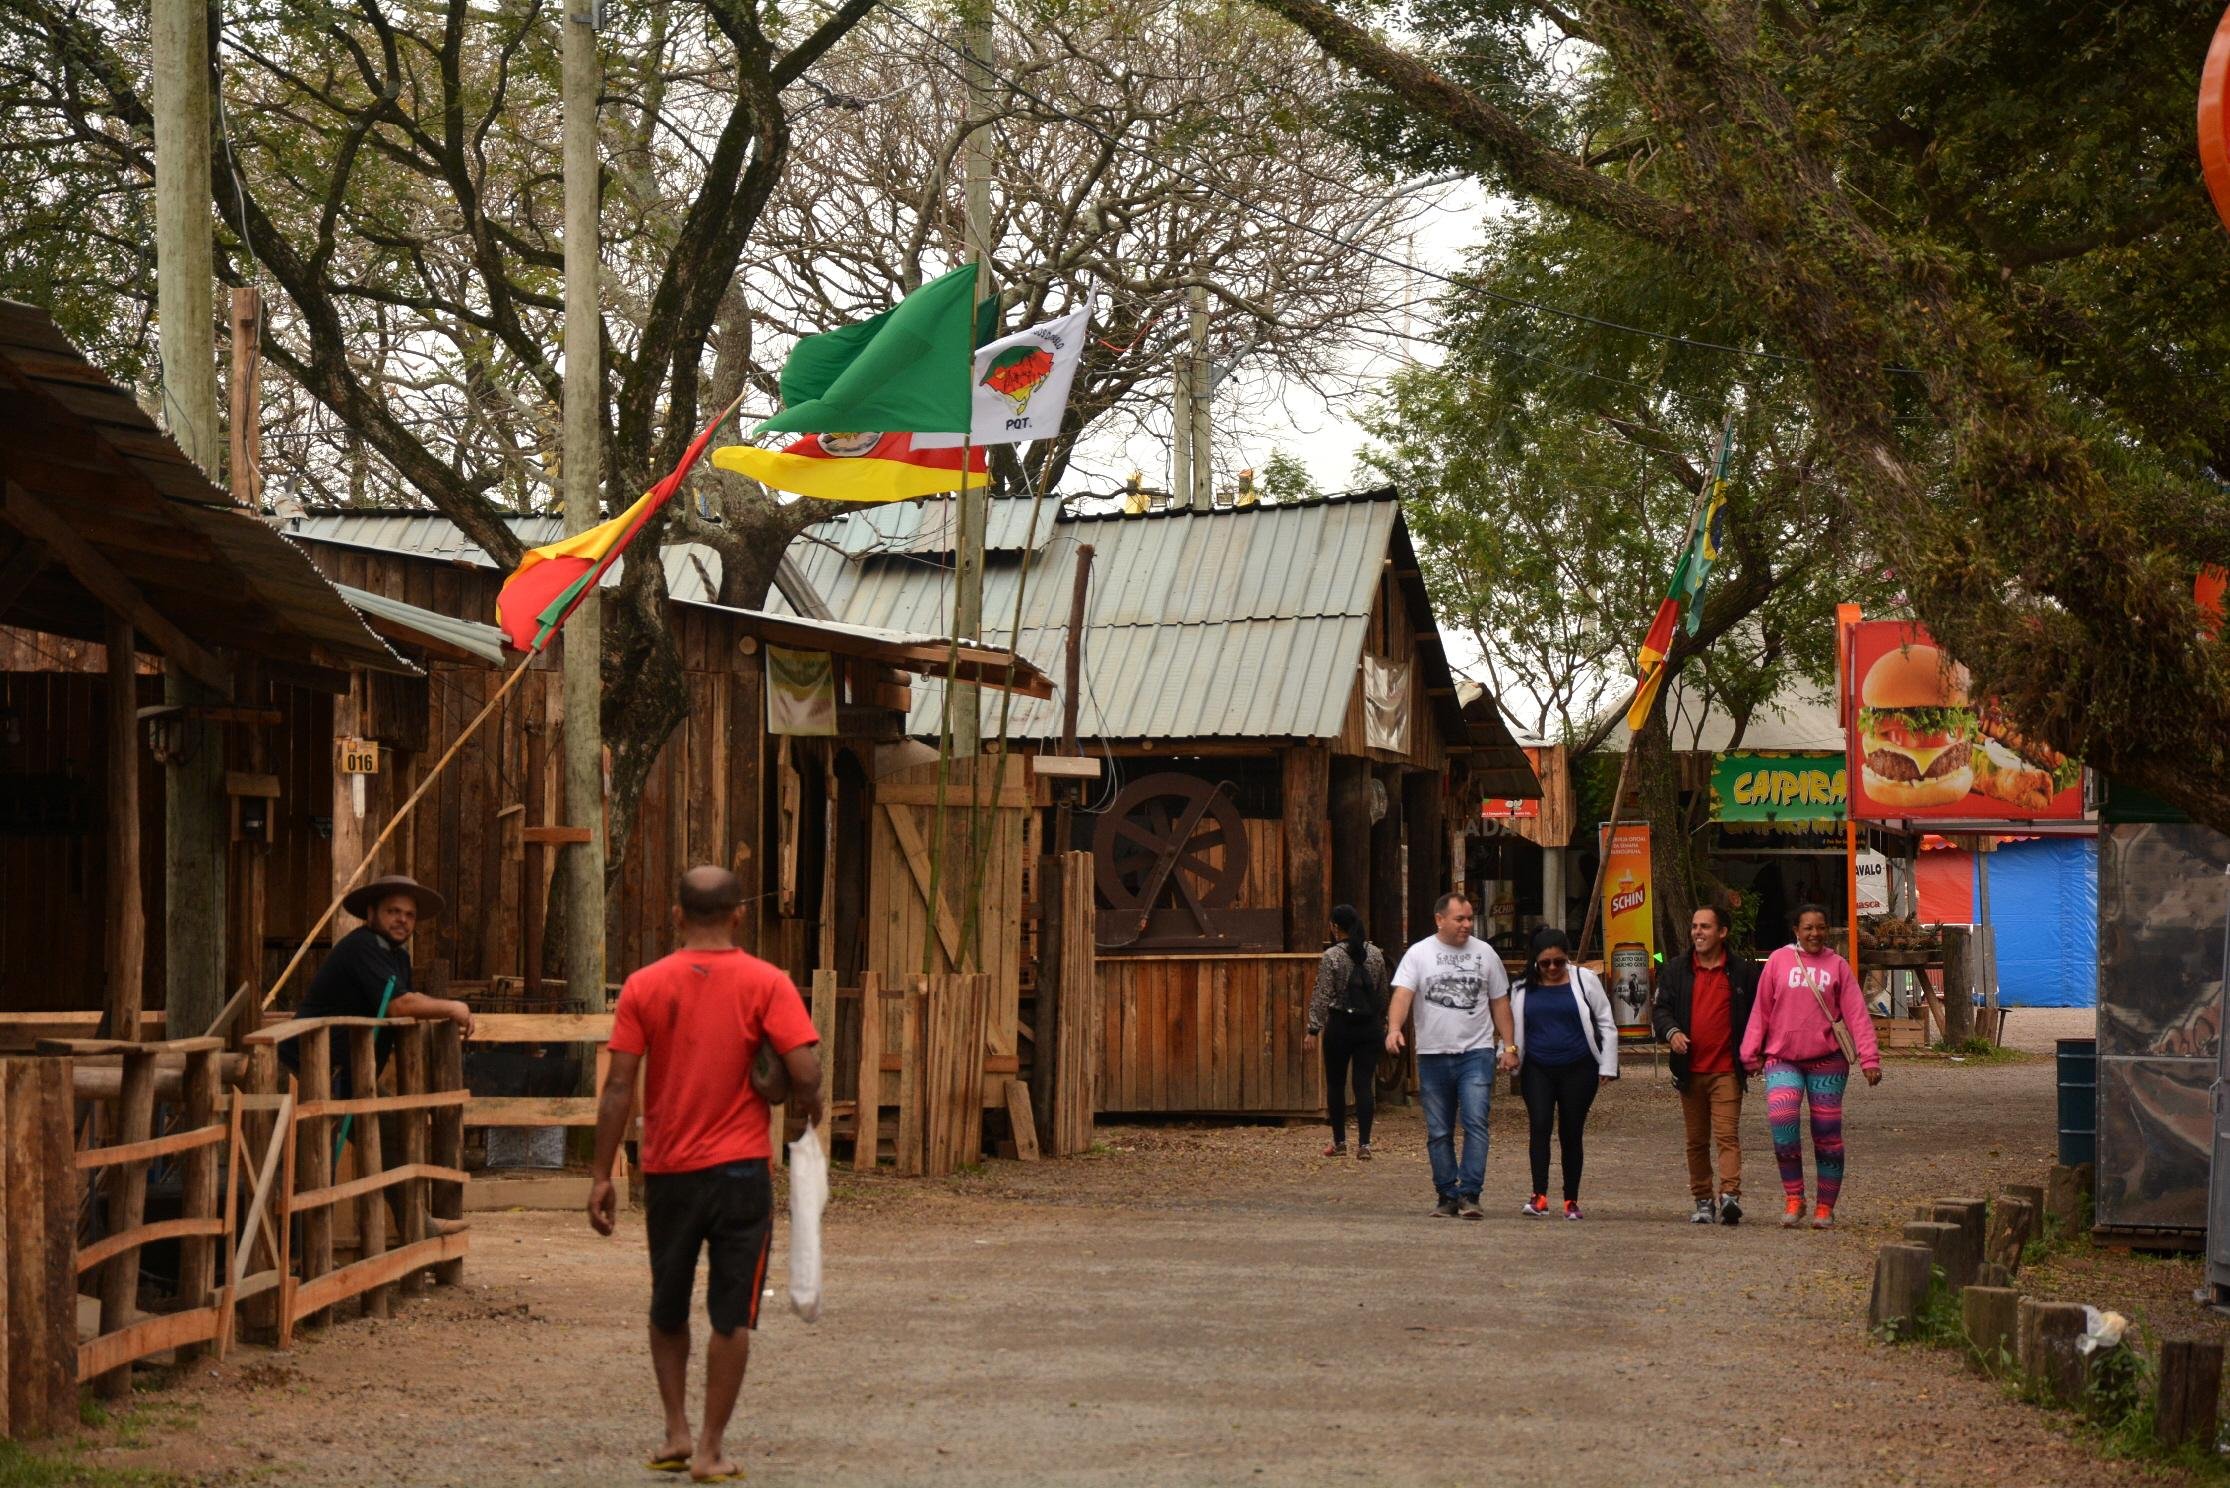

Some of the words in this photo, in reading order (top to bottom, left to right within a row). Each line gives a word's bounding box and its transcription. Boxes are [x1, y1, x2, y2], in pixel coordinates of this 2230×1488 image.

[348, 754, 373, 771] 016
[1734, 769, 1847, 806] CAIPIRA
[1612, 890, 1644, 912] SCHIN
[1788, 966, 1831, 992] GAP
